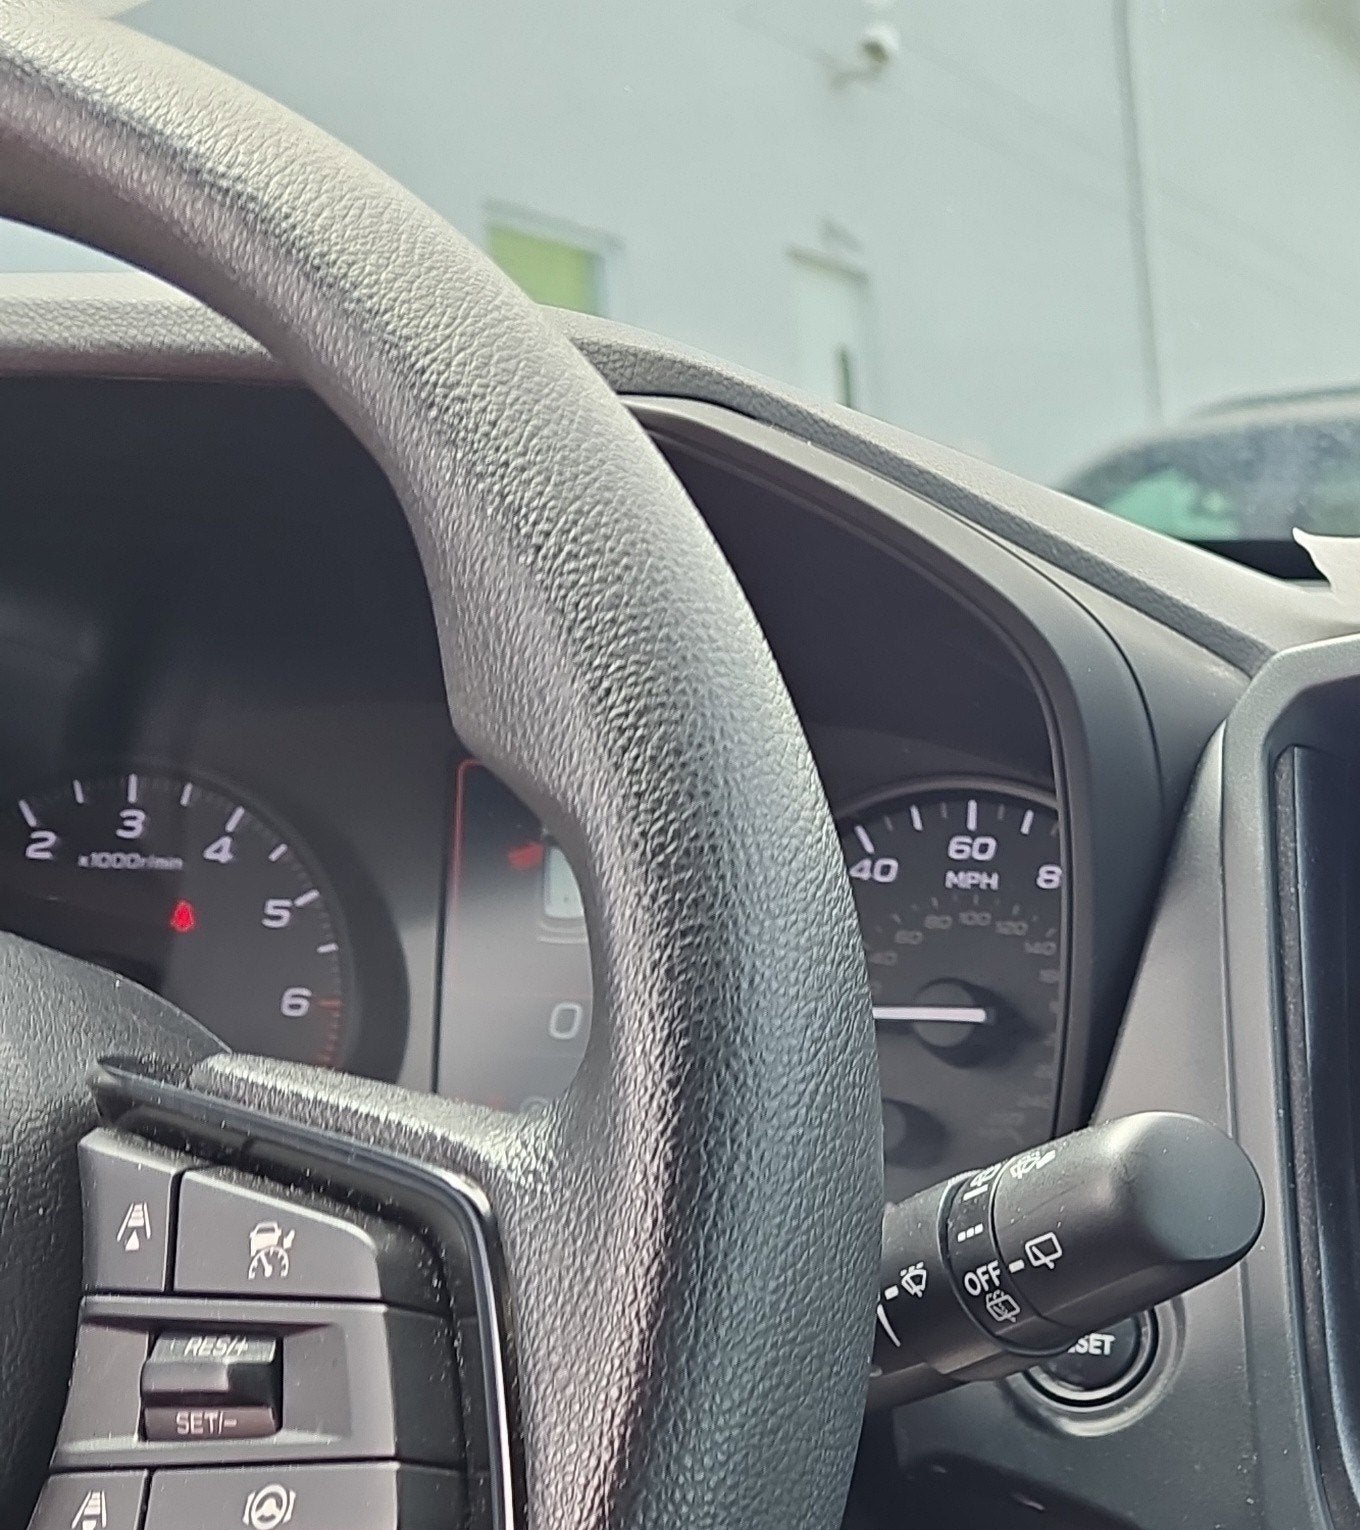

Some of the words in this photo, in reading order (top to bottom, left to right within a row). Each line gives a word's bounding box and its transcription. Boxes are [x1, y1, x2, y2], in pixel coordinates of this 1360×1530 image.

[116, 808, 147, 839] 3
[25, 830, 58, 860] 2
[203, 836, 234, 864] 4
[948, 835, 997, 861] 60
[849, 856, 899, 884] 40
[945, 870, 999, 890] MPH
[1035, 863, 1062, 891] 8
[262, 899, 293, 928] 5
[280, 987, 312, 1017] 6
[963, 1260, 1001, 1296] OFF
[1068, 1332, 1117, 1356] SET
